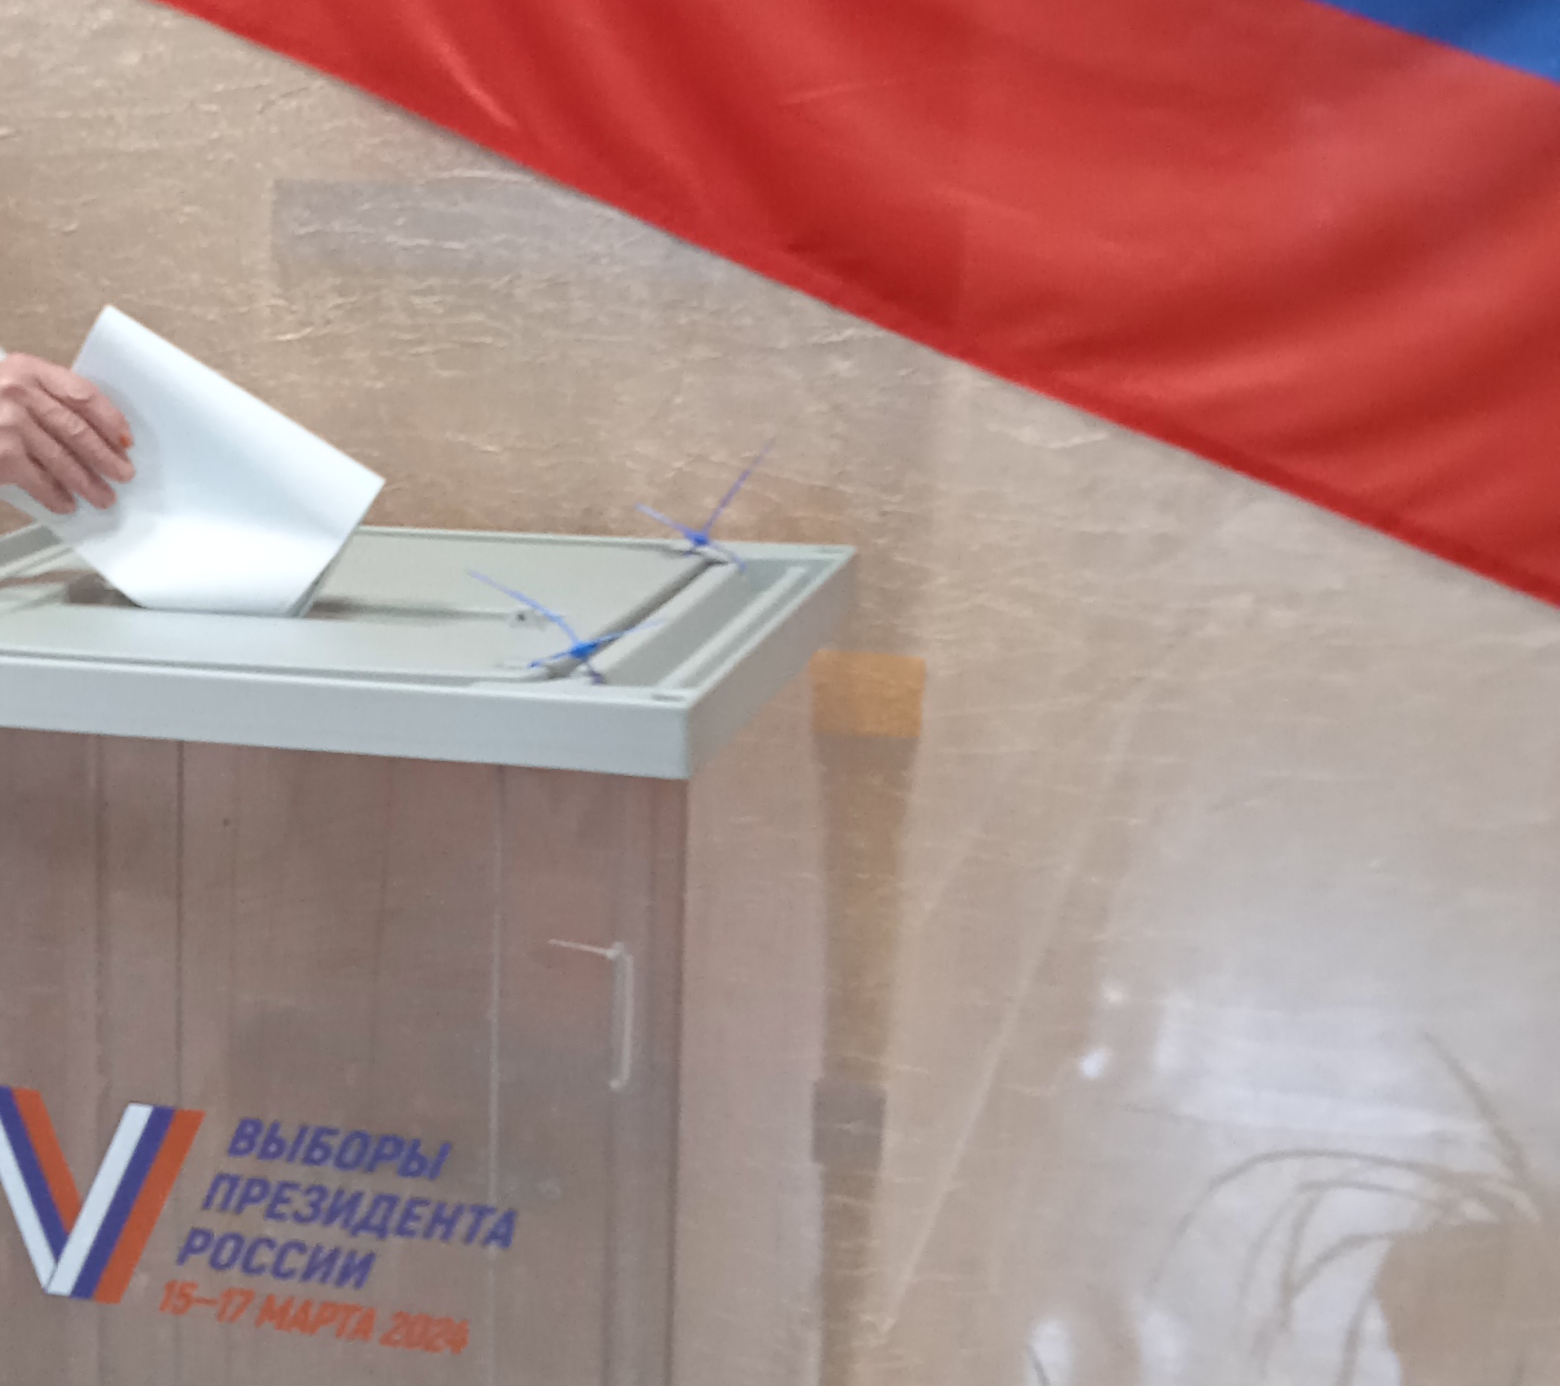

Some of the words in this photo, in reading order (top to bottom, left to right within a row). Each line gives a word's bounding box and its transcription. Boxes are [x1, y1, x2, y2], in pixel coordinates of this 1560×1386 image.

[226, 1116, 452, 1182] ВЫБОРЫ
[201, 1172, 519, 1249] ПРЕЗИДЕНТА
[175, 1226, 377, 1290] РОССИИ
[254, 1293, 377, 1343] МАРТА
[379, 1310, 470, 1355] 2024
